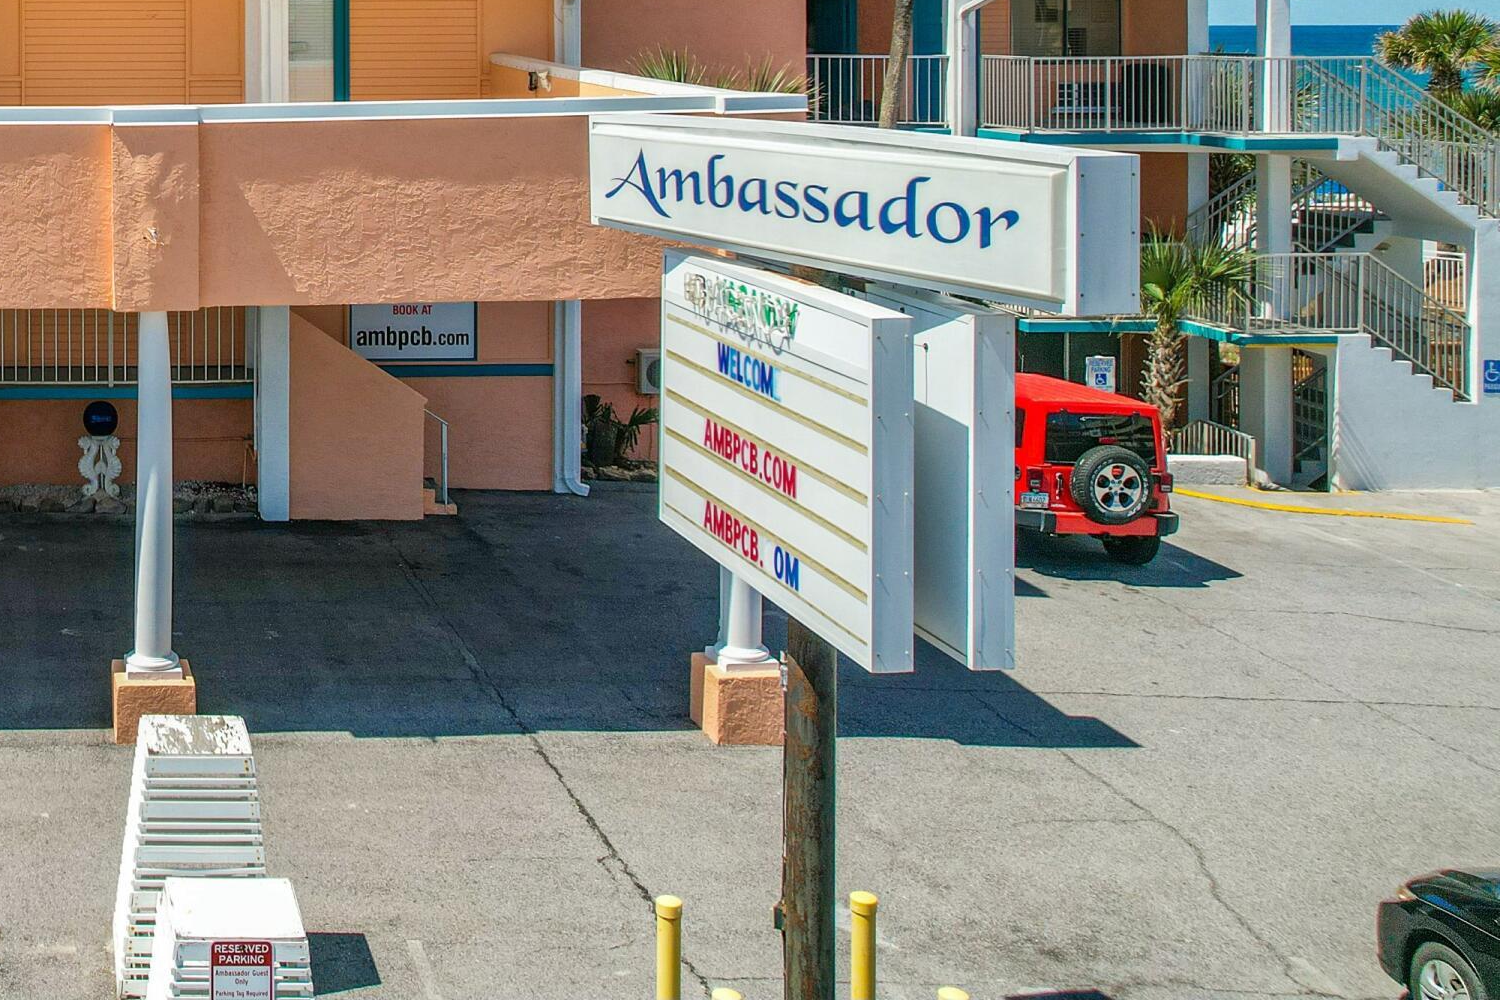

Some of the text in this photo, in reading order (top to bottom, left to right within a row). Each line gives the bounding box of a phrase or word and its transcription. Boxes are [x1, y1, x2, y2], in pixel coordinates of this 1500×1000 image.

[604, 146, 1020, 249] Ambassador
[393, 304, 433, 315] BOOK AT
[356, 326, 469, 350] ambpcb.com
[703, 418, 797, 499] AMBPCB.COM
[214, 944, 269, 953] RESERVED
[218, 955, 265, 964] PARKING
[215, 969, 269, 977] Ambassador Guest
[234, 978, 249, 986] Only
[215, 990, 235, 998] Parking
[246, 990, 269, 998] Required
